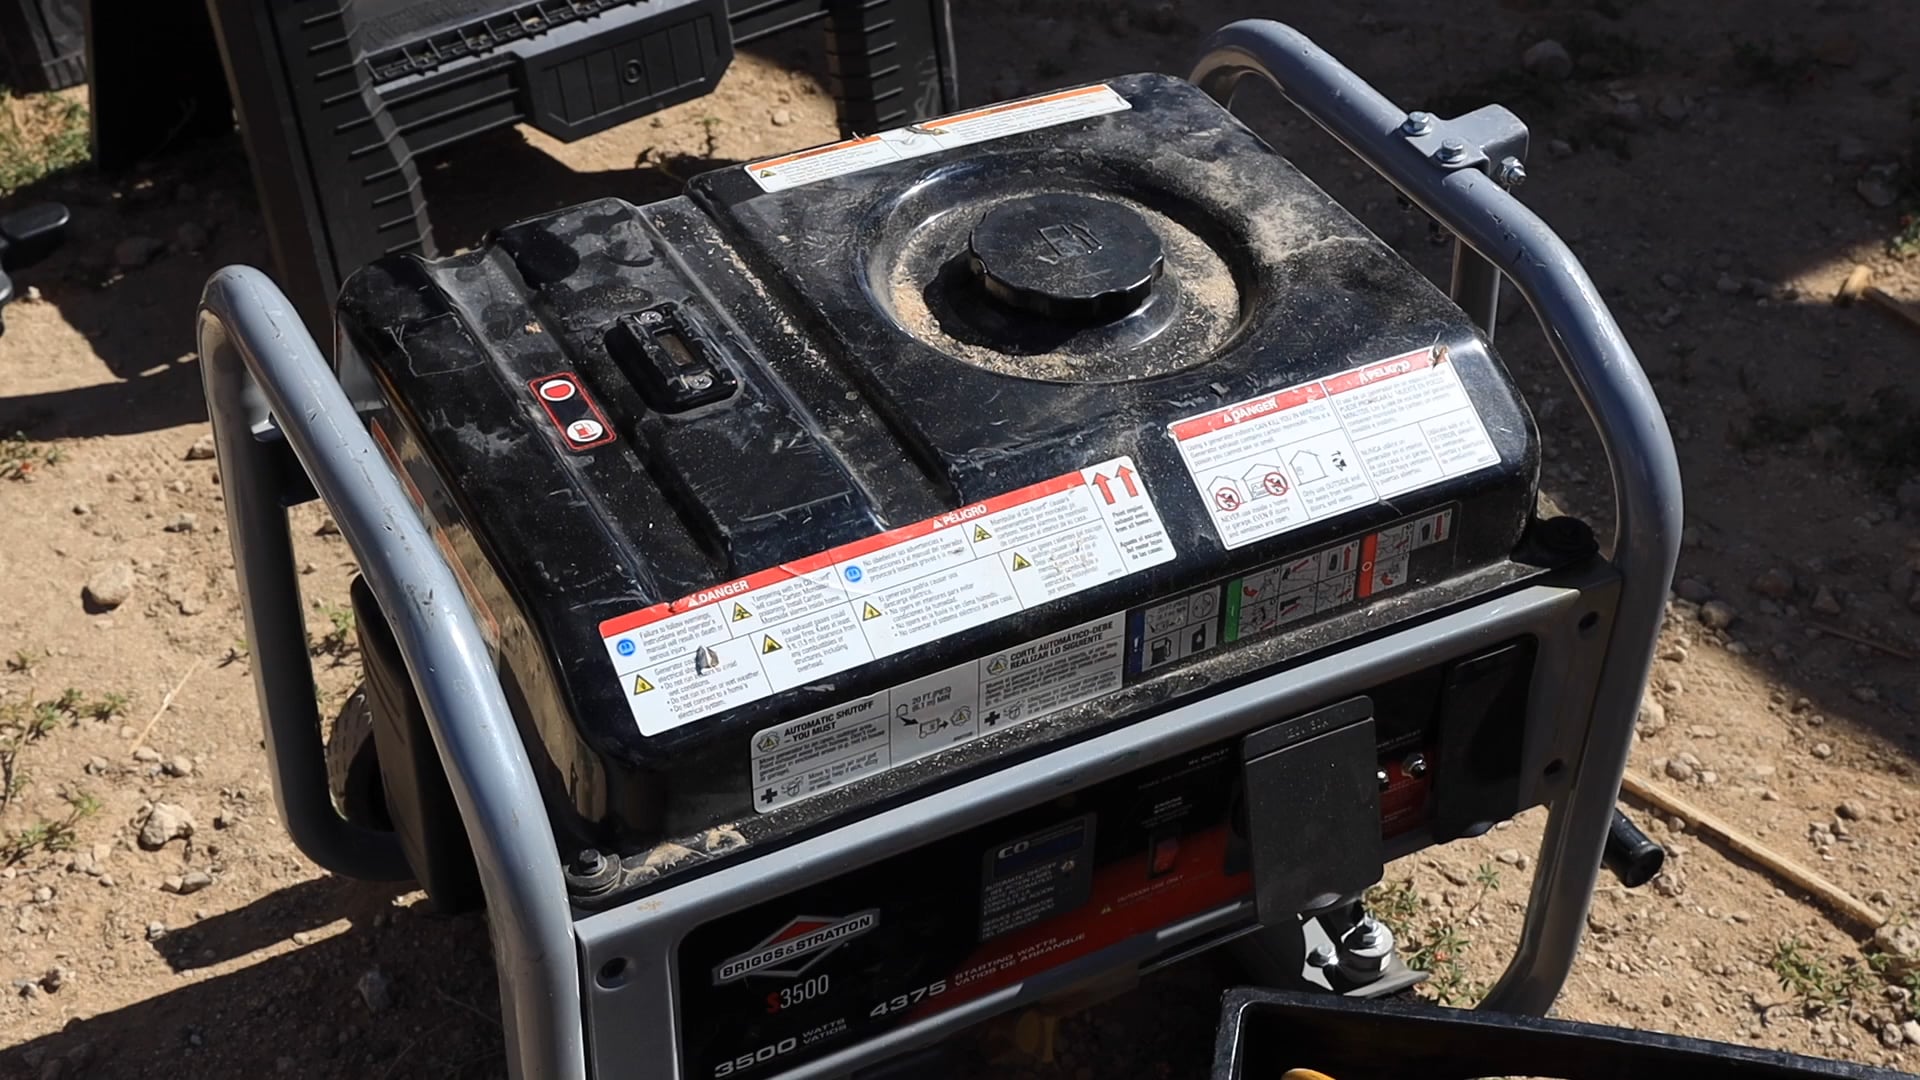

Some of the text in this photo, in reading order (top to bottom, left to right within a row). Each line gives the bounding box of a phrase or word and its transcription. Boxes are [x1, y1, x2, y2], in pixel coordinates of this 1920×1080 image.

[1230, 398, 1279, 420] DANGER
[940, 503, 988, 526] PELIGRO
[696, 578, 750, 604] DANGER
[1009, 649, 1049, 670] REALIZAR
[1049, 645, 1061, 656] LO
[1062, 631, 1103, 653] SIGUIENTE
[1009, 645, 1036, 662] CORTE
[783, 699, 874, 737] AUTOMATIC SHUTOFF
[792, 729, 810, 743] YOU
[811, 721, 836, 736] MUST
[722, 914, 872, 978] BRIGGS&STRATTON
[954, 930, 1086, 988] VATIOS DE ARRANQUE
[955, 936, 1057, 980] STARTING WATTS
[766, 974, 830, 1014] S3500
[868, 977, 947, 1021] 4375
[801, 1016, 845, 1039] WATTS
[802, 1021, 847, 1046] VATIOS
[714, 1037, 797, 1079] 3500
